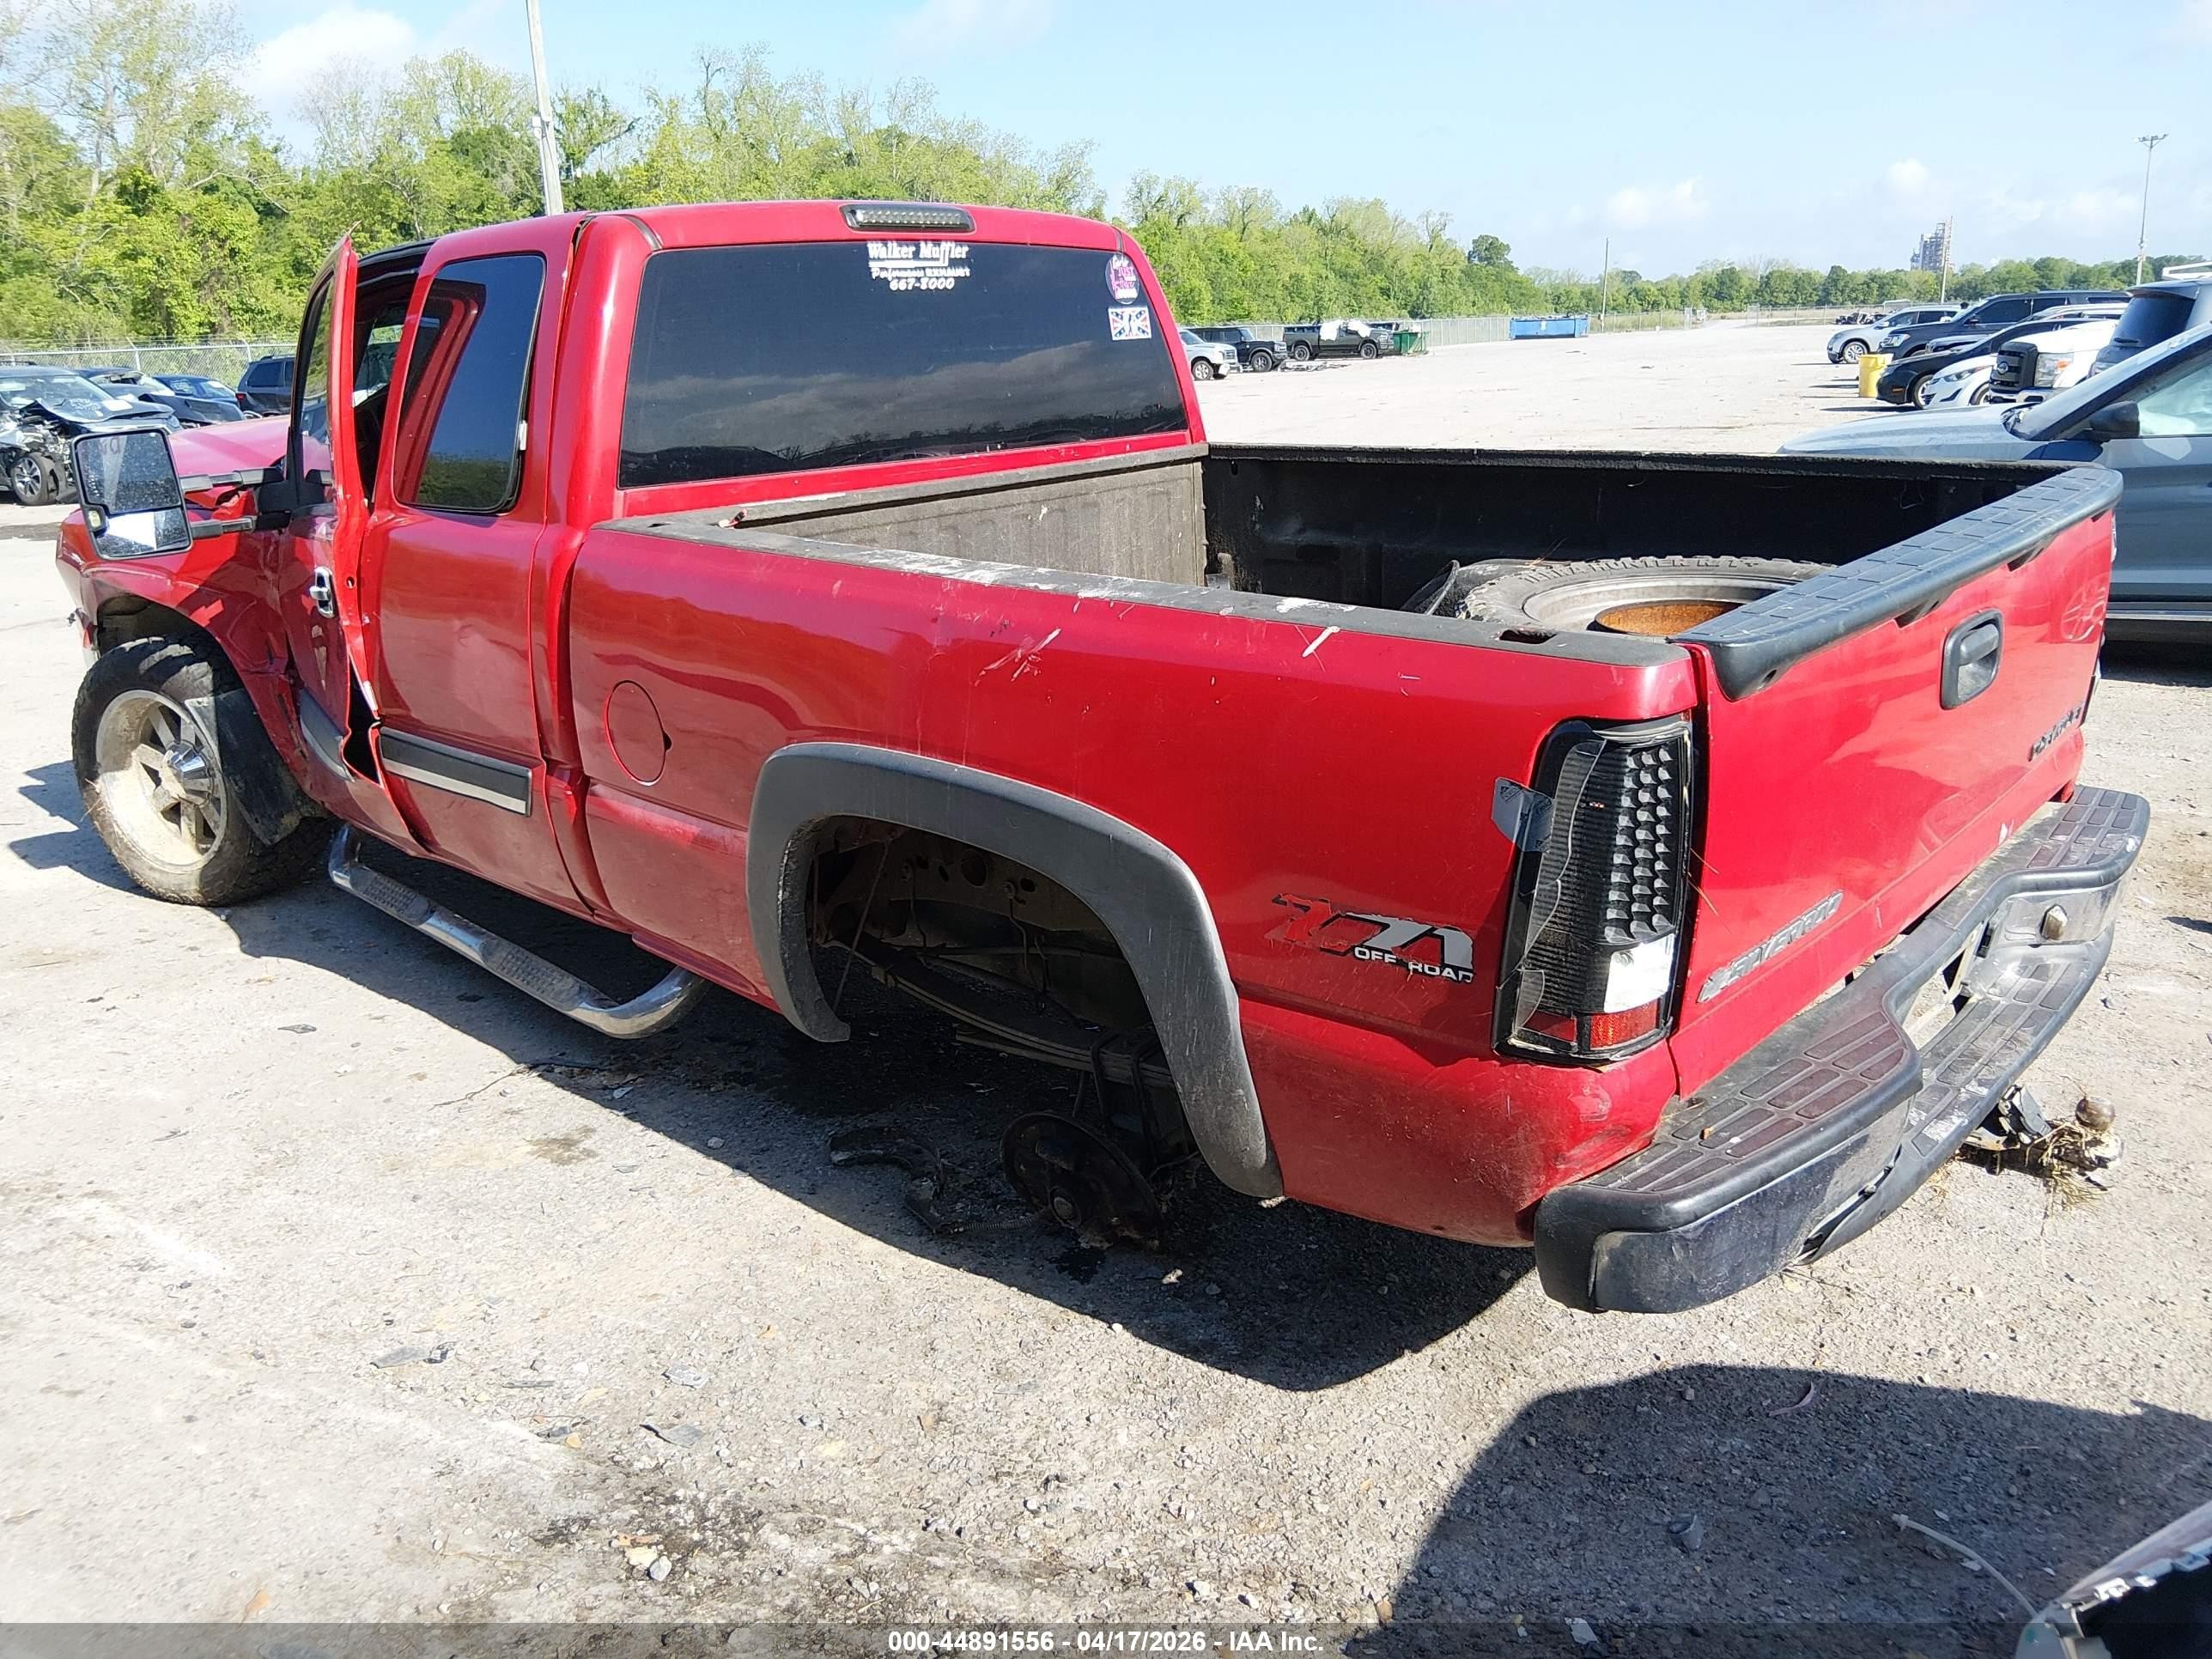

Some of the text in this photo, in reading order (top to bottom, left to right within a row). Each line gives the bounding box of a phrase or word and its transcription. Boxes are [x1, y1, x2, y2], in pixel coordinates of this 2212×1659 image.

[866, 241, 969, 260] Walker Muffler
[1353, 945, 1475, 984] OFF ROAD
